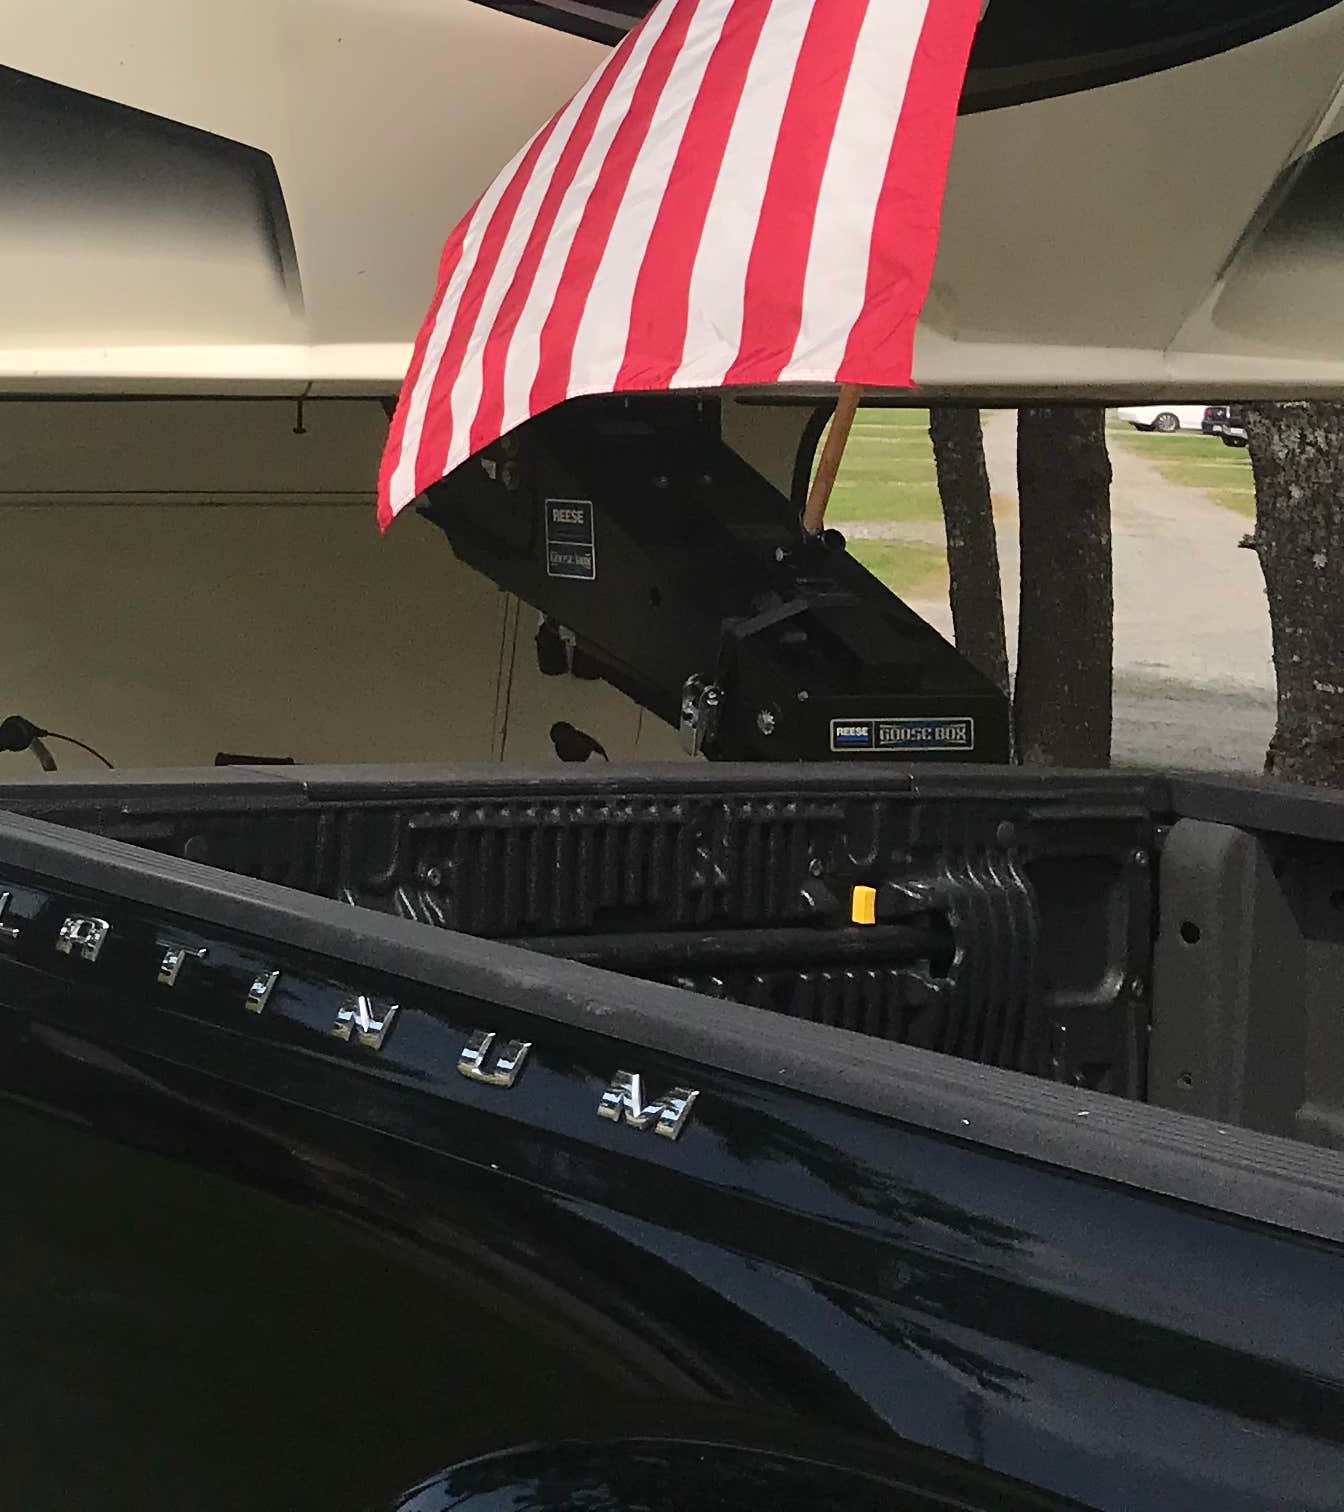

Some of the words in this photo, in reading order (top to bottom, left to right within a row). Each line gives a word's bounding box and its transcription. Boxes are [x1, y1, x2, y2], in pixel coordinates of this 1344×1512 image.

[553, 509, 584, 524] REESE
[836, 727, 869, 737] REESE
[879, 727, 932, 742] GOOSE
[934, 726, 967, 742] BOX
